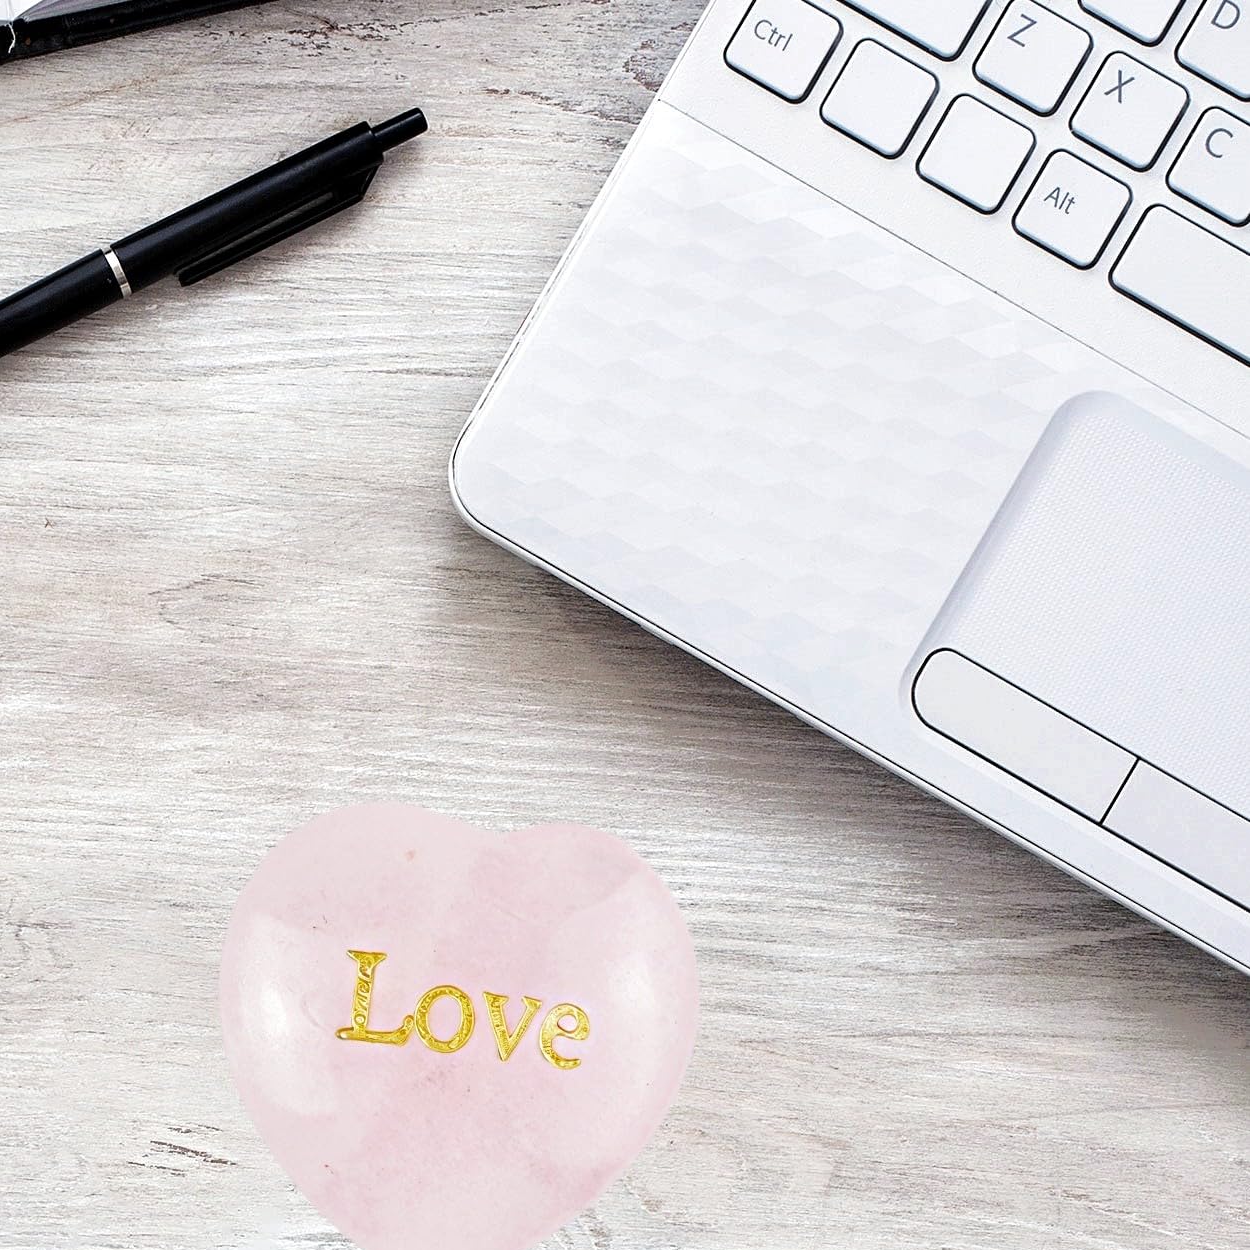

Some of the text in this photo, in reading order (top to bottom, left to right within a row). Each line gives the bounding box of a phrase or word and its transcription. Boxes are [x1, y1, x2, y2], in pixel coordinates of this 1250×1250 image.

[1007, 12, 1038, 48] Z
[1210, 0, 1241, 30] D
[753, 19, 794, 52] Ctrl
[1103, 69, 1136, 104] X
[1205, 127, 1234, 159] C
[1043, 186, 1077, 215] Alt
[334, 949, 592, 1070] Love
